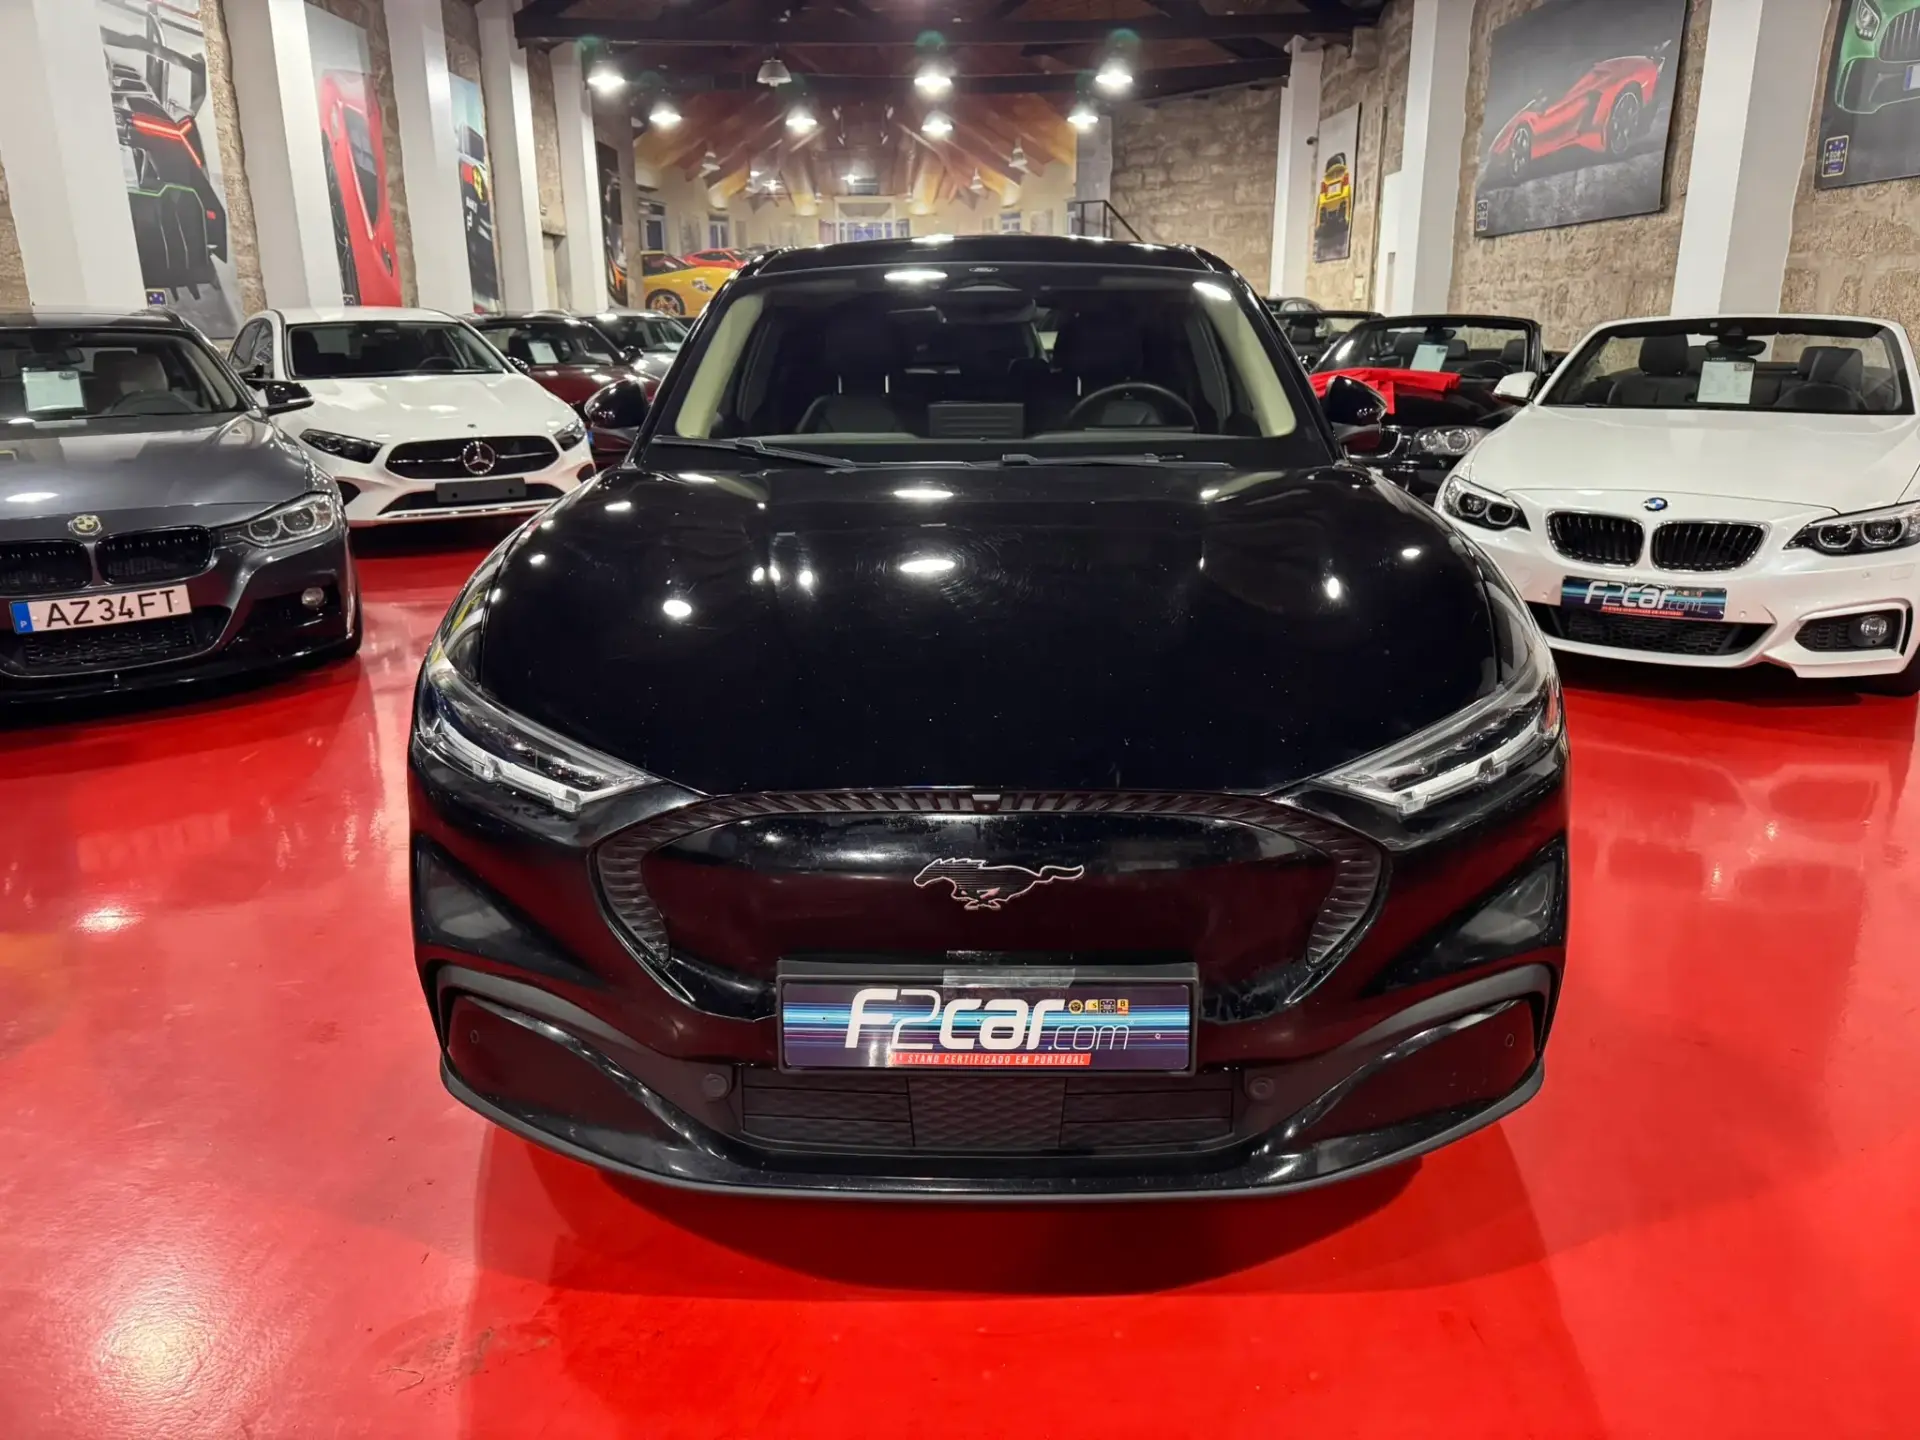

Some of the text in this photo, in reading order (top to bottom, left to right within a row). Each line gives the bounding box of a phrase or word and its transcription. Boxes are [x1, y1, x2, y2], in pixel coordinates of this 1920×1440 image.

[46, 589, 175, 628] AZ34FT
[844, 988, 1130, 1051] F2car.com
[907, 1054, 940, 1065] STAND
[943, 1054, 1011, 1065] CERTIFICADO
[1015, 1055, 1029, 1065] EM
[1033, 1055, 1085, 1065] PORTUGAL
